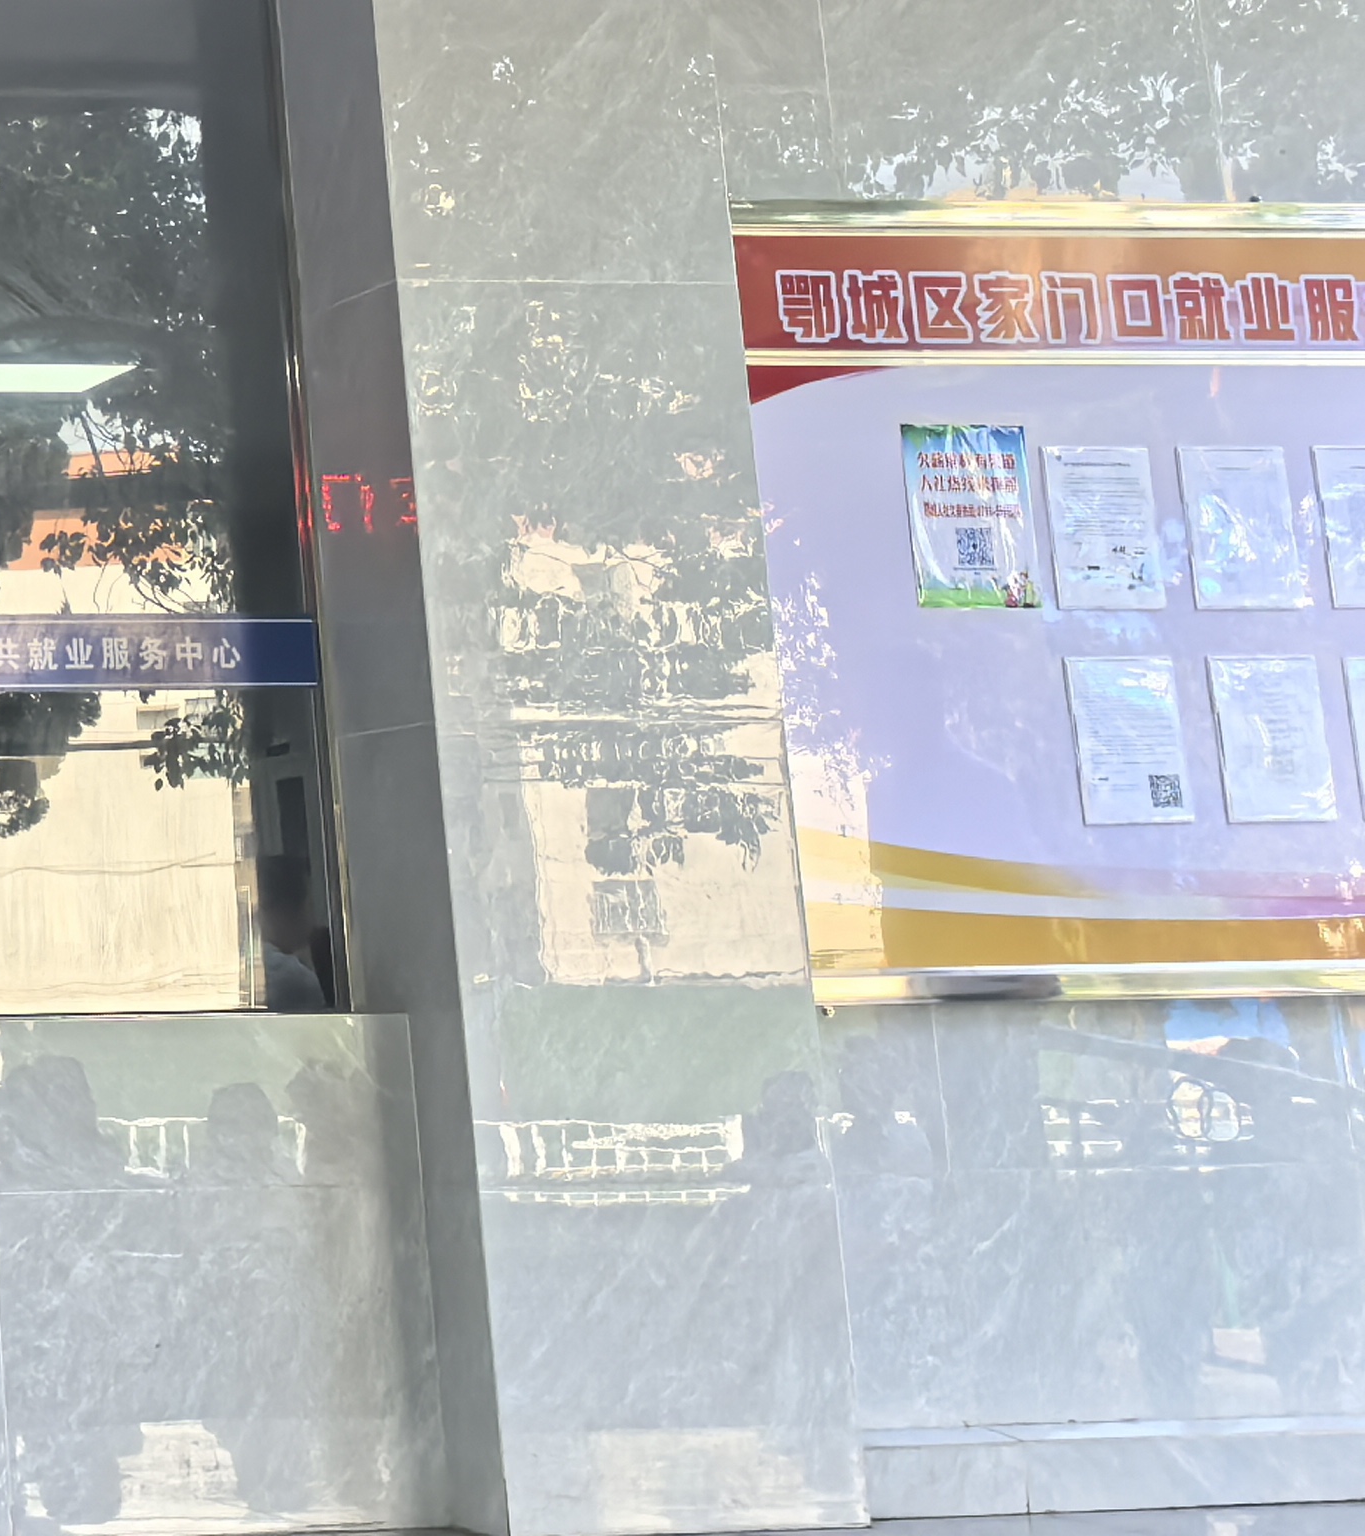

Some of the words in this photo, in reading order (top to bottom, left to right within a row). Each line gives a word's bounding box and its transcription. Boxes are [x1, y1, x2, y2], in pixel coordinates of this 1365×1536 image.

[775, 270, 1361, 344] 鄂城区家门口就业服
